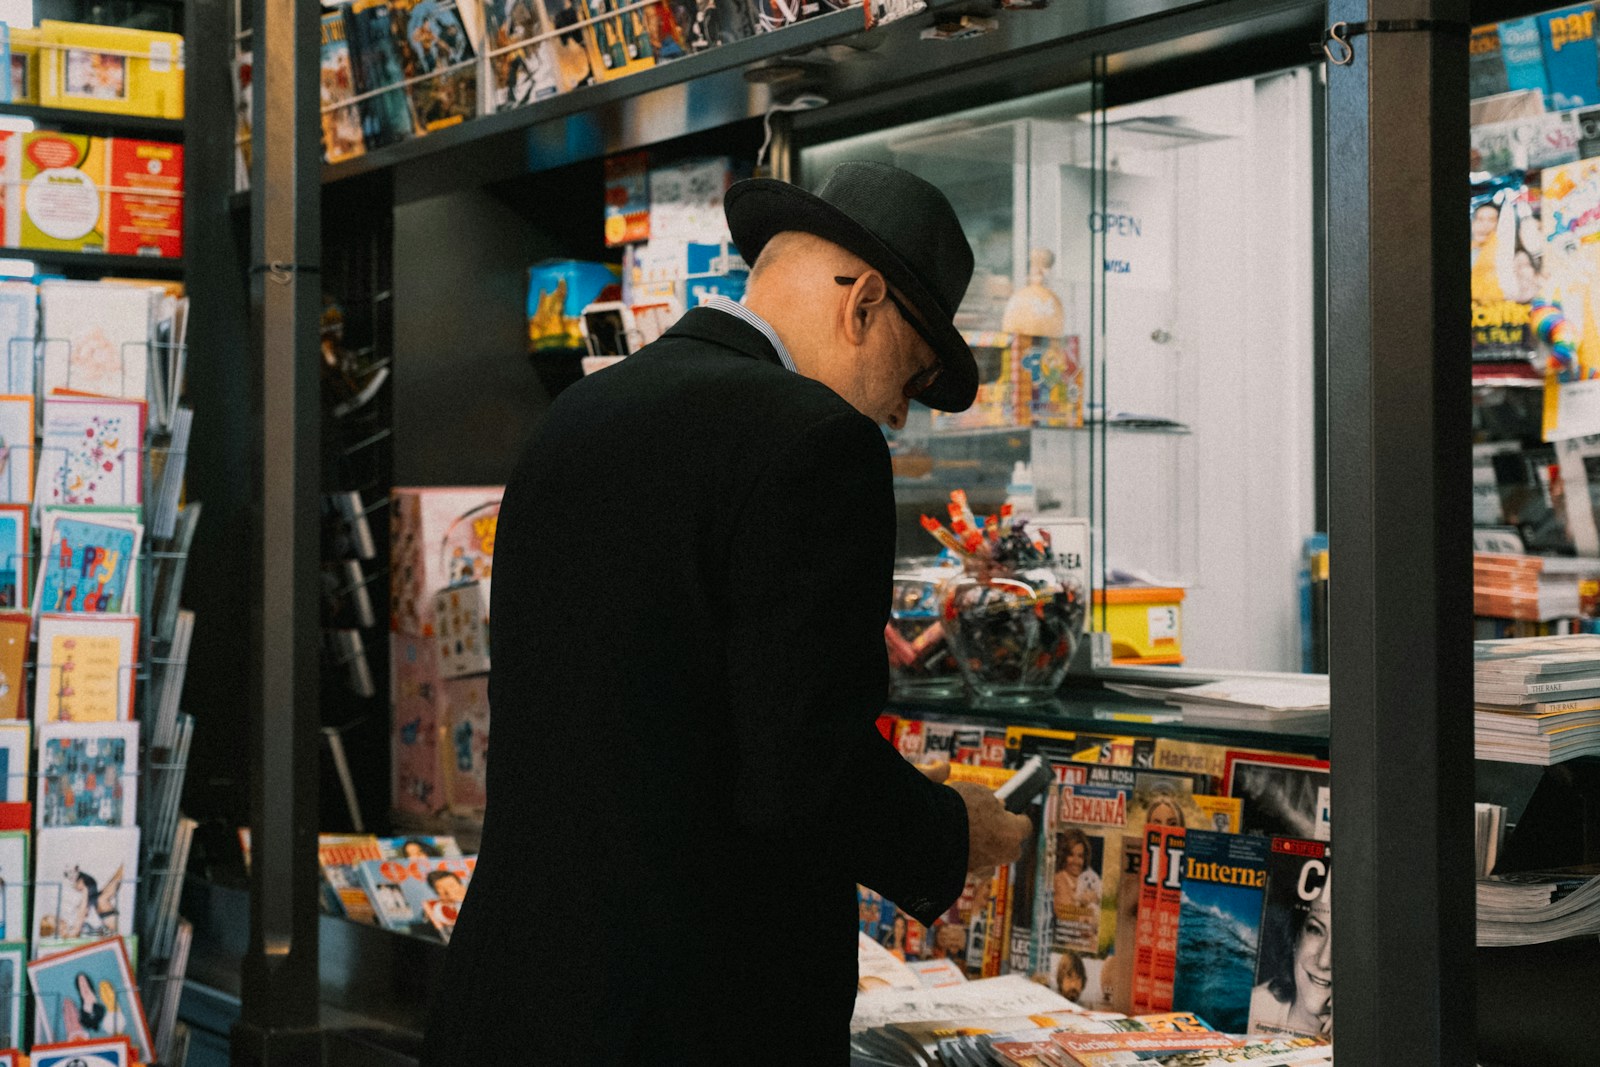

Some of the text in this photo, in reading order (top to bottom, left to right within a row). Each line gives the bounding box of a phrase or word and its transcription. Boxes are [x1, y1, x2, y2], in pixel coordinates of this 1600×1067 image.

[1088, 212, 1142, 237] OPEN
[1532, 683, 1562, 693] THE RAKE
[1550, 704, 1561, 712] THE
[1091, 767, 1134, 784] ANA ROSA
[1061, 786, 1127, 826] SEMANA
[1186, 858, 1267, 888] Interna
[1068, 1040, 1116, 1051] Cucine
